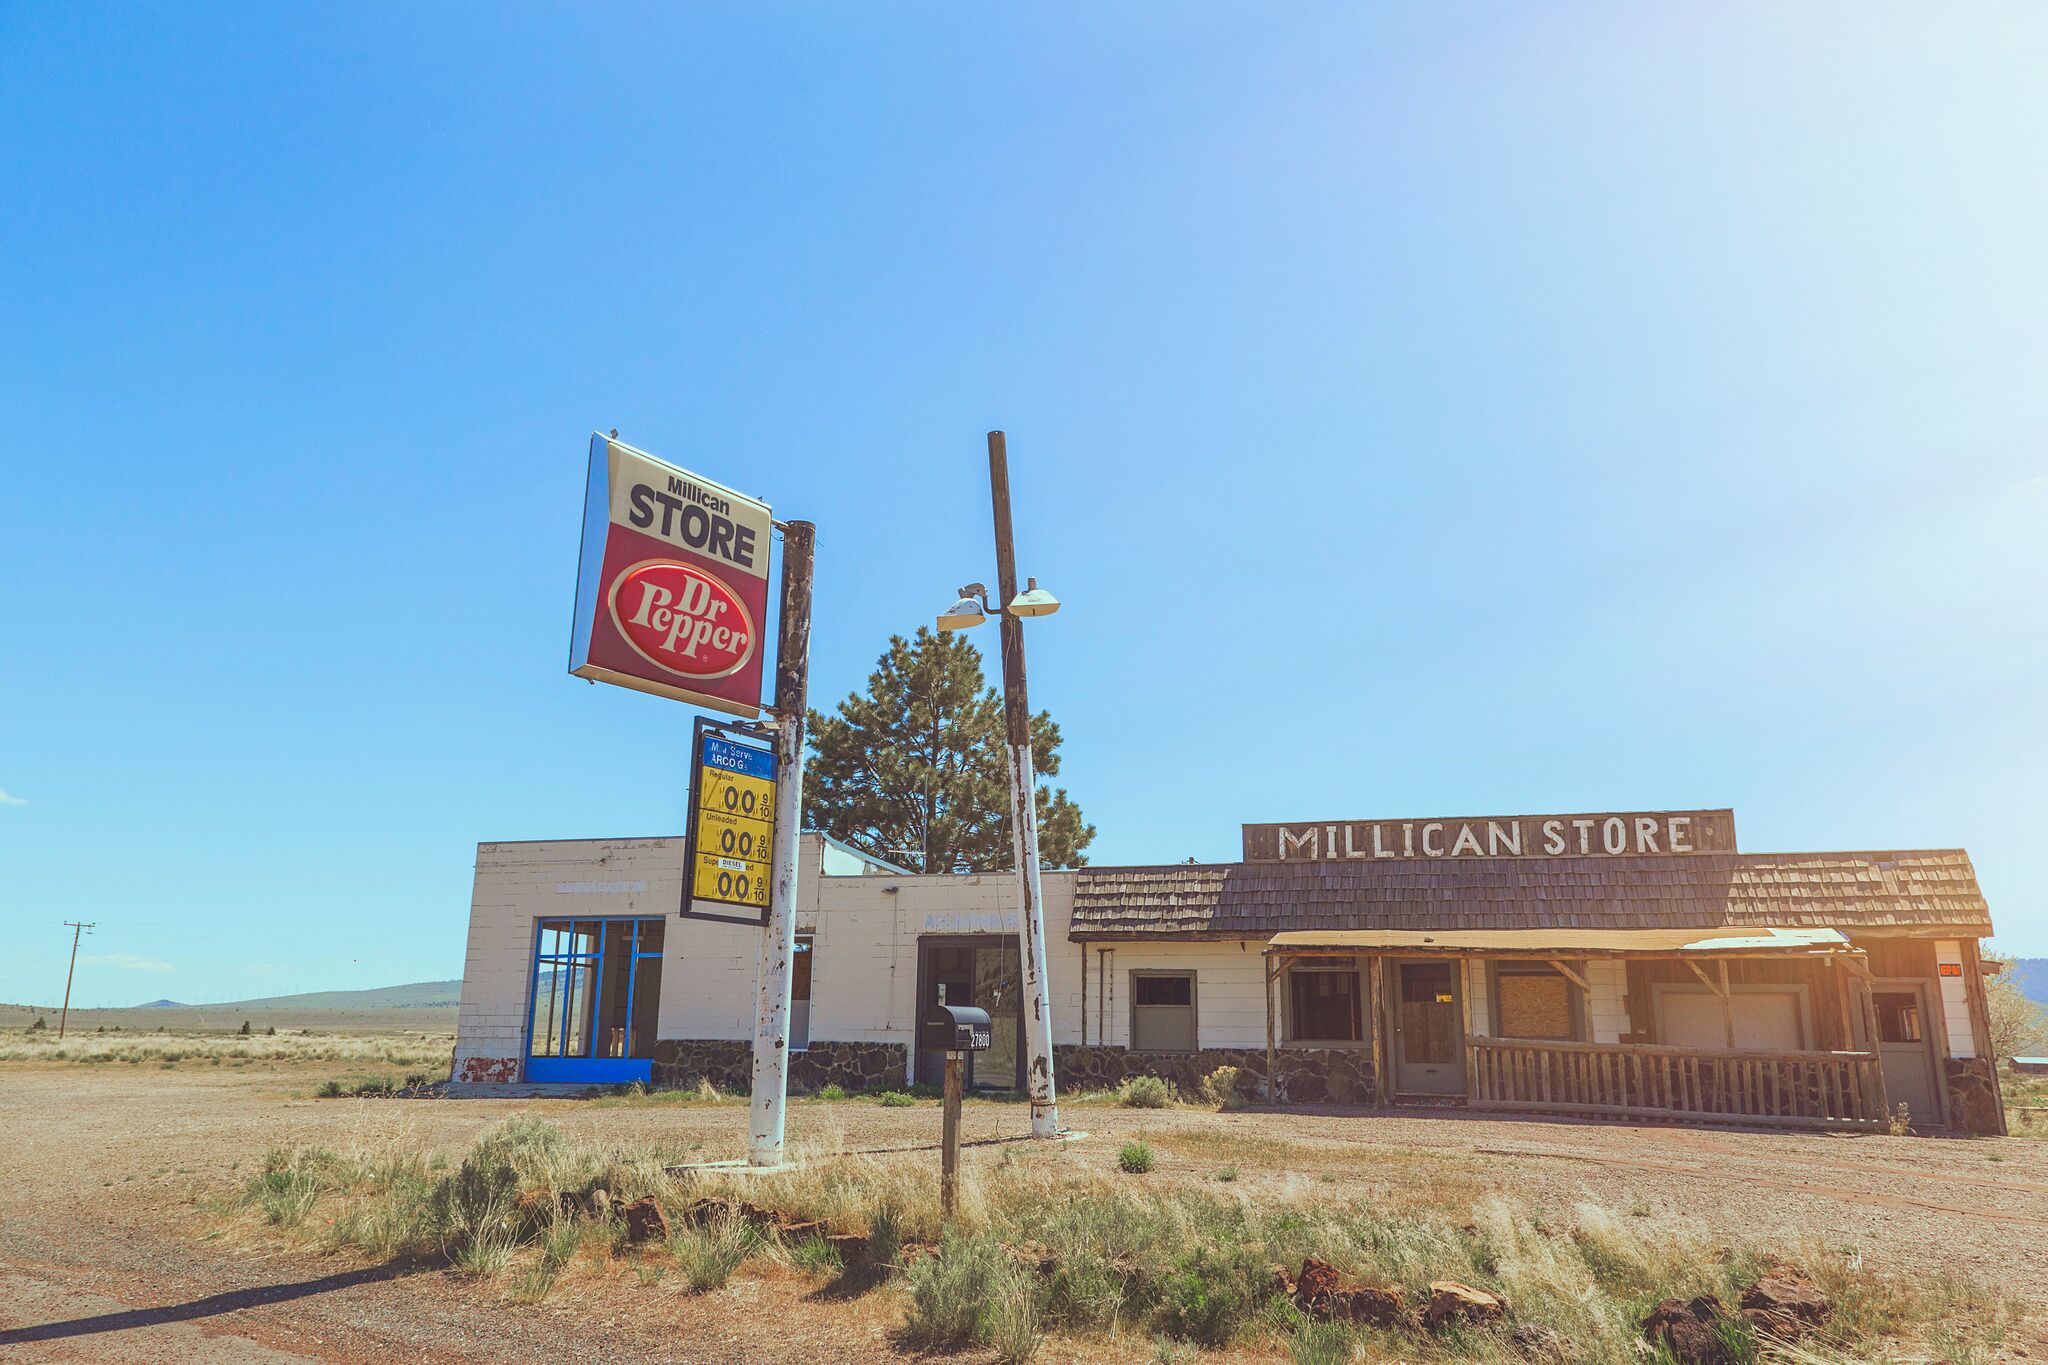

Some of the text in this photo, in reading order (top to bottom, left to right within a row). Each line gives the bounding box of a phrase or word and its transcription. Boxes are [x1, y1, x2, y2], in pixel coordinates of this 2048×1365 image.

[668, 475, 730, 515] Millican
[629, 483, 756, 569] STORE
[673, 574, 728, 622] Dr
[628, 580, 748, 659] Pepper
[709, 769, 734, 781] Regular
[711, 754, 736, 768] ARCO
[724, 785, 755, 814] 00
[706, 813, 737, 825] Unleaded
[721, 828, 753, 856] 00
[1279, 816, 1693, 861] MILLICAN STORE
[722, 859, 742, 867] DIESEL
[717, 871, 749, 899] 00
[971, 1033, 990, 1047] 27800
